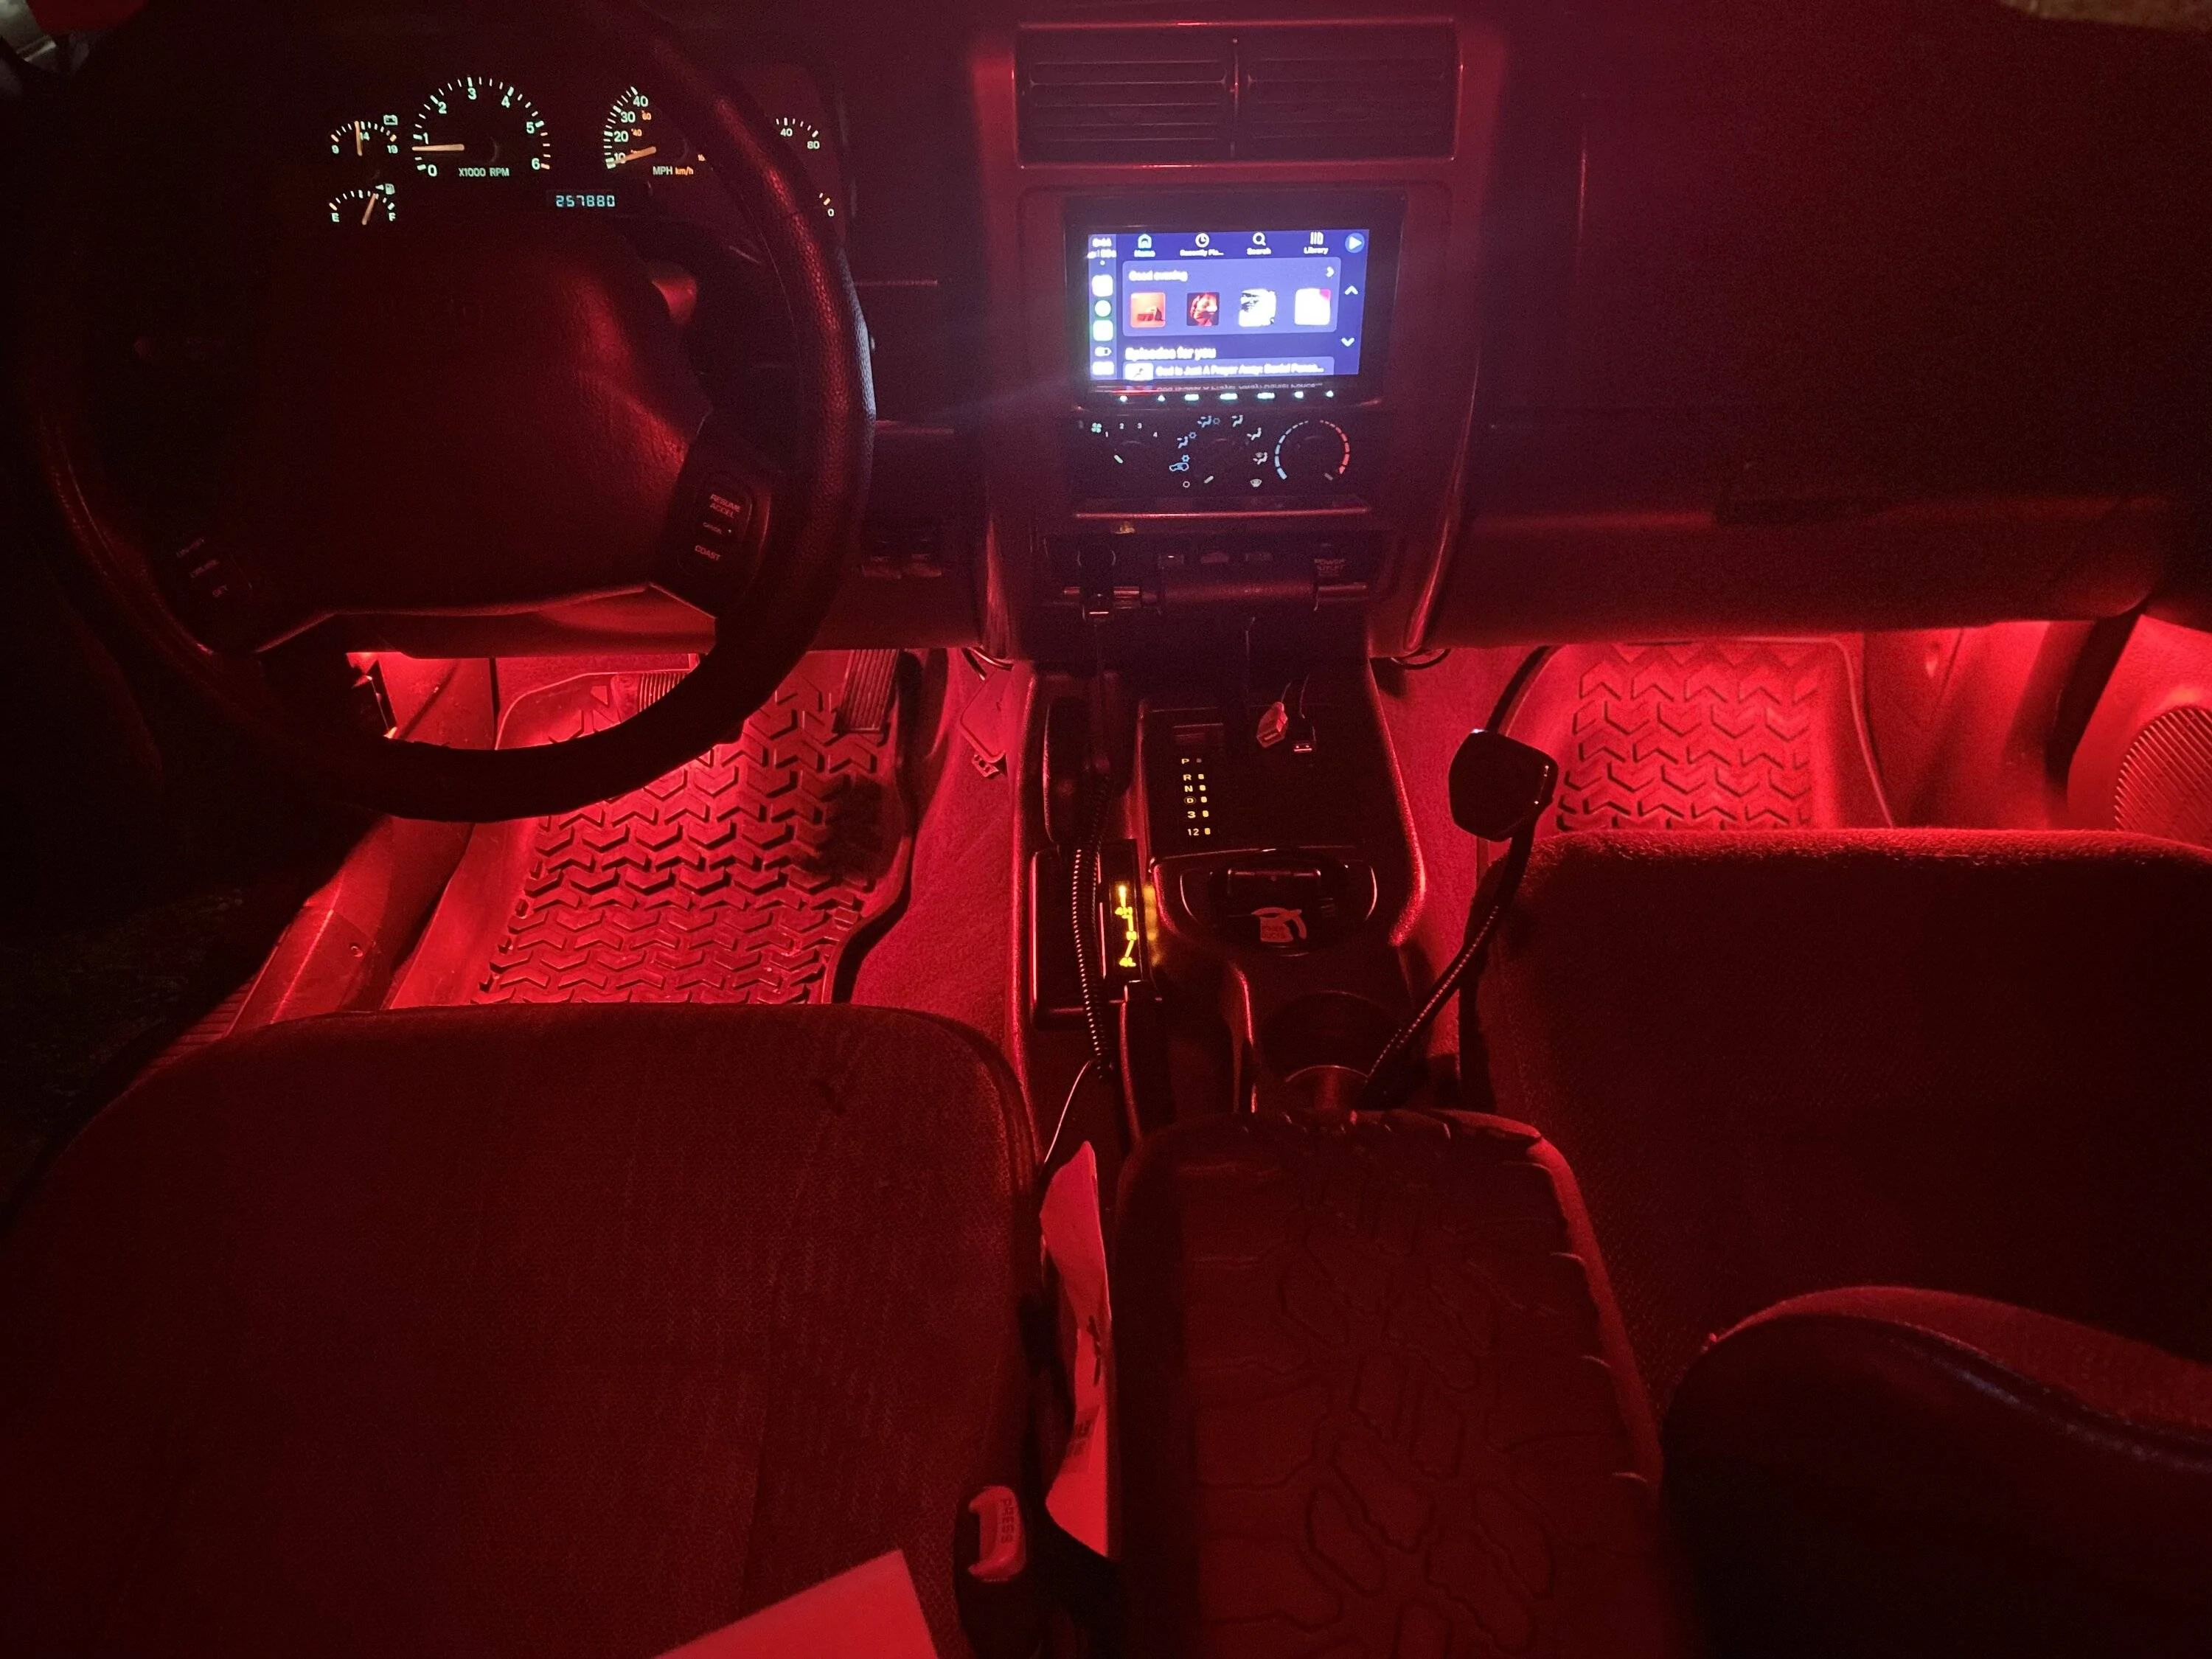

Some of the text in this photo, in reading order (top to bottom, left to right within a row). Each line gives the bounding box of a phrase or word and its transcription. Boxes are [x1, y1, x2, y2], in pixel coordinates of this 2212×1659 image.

[467, 88, 477, 100] 3
[501, 95, 510, 108] 4
[633, 95, 649, 107] 40
[438, 102, 447, 114] 2
[620, 111, 636, 122] 30
[526, 122, 535, 133] 5
[780, 128, 793, 137] 40
[422, 132, 428, 145] 1
[613, 131, 629, 142] 20
[807, 141, 820, 150] 80
[531, 158, 540, 170] 6
[427, 164, 437, 177] 0
[459, 167, 509, 177] X1000 RPM
[653, 166, 694, 175] MPH km/h
[556, 195, 616, 207] 257880
[331, 212, 339, 222] E
[389, 212, 396, 221] F
[827, 209, 835, 217] 0
[1129, 271, 1187, 282] Good evening
[1125, 347, 1216, 361] Episodes for you
[1203, 365, 1210, 375] A
[710, 503, 734, 518] ACCEL
[695, 545, 720, 561] COAST
[1187, 810, 1196, 818] 3
[1001, 1498, 1015, 1544] PRESS
